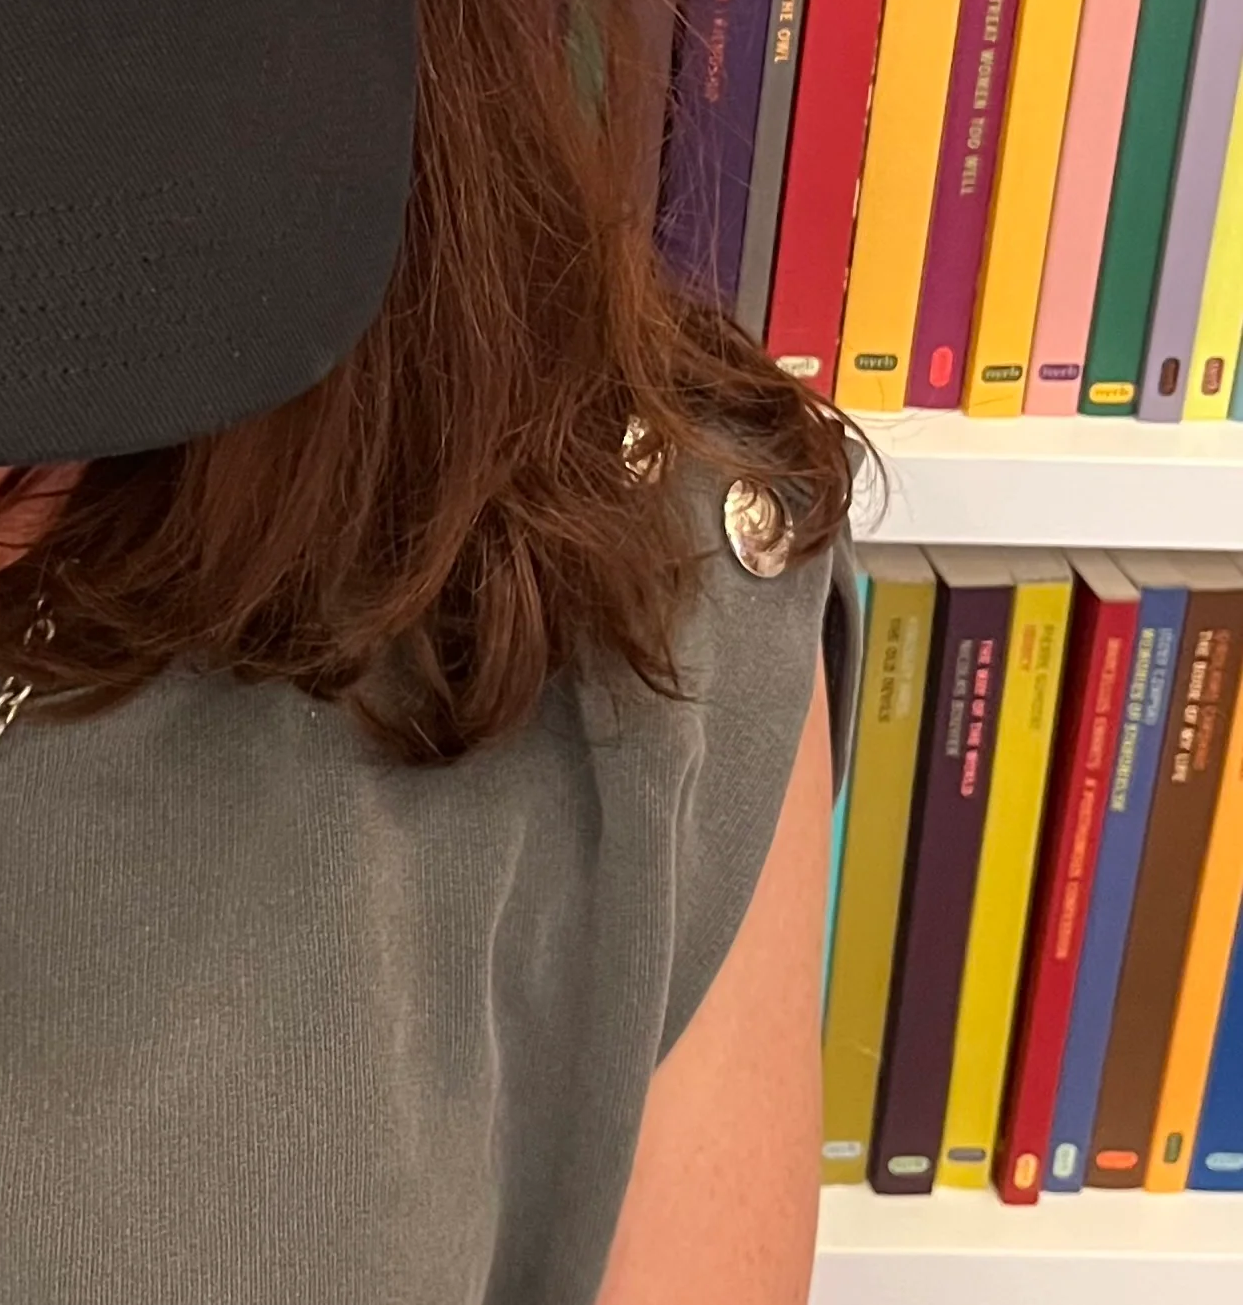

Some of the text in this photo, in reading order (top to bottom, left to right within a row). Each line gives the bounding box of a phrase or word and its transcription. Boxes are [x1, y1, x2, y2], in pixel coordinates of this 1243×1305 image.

[774, 29, 792, 63] OWL
[972, 47, 996, 110] WOMEN
[959, 154, 979, 196] WELL
